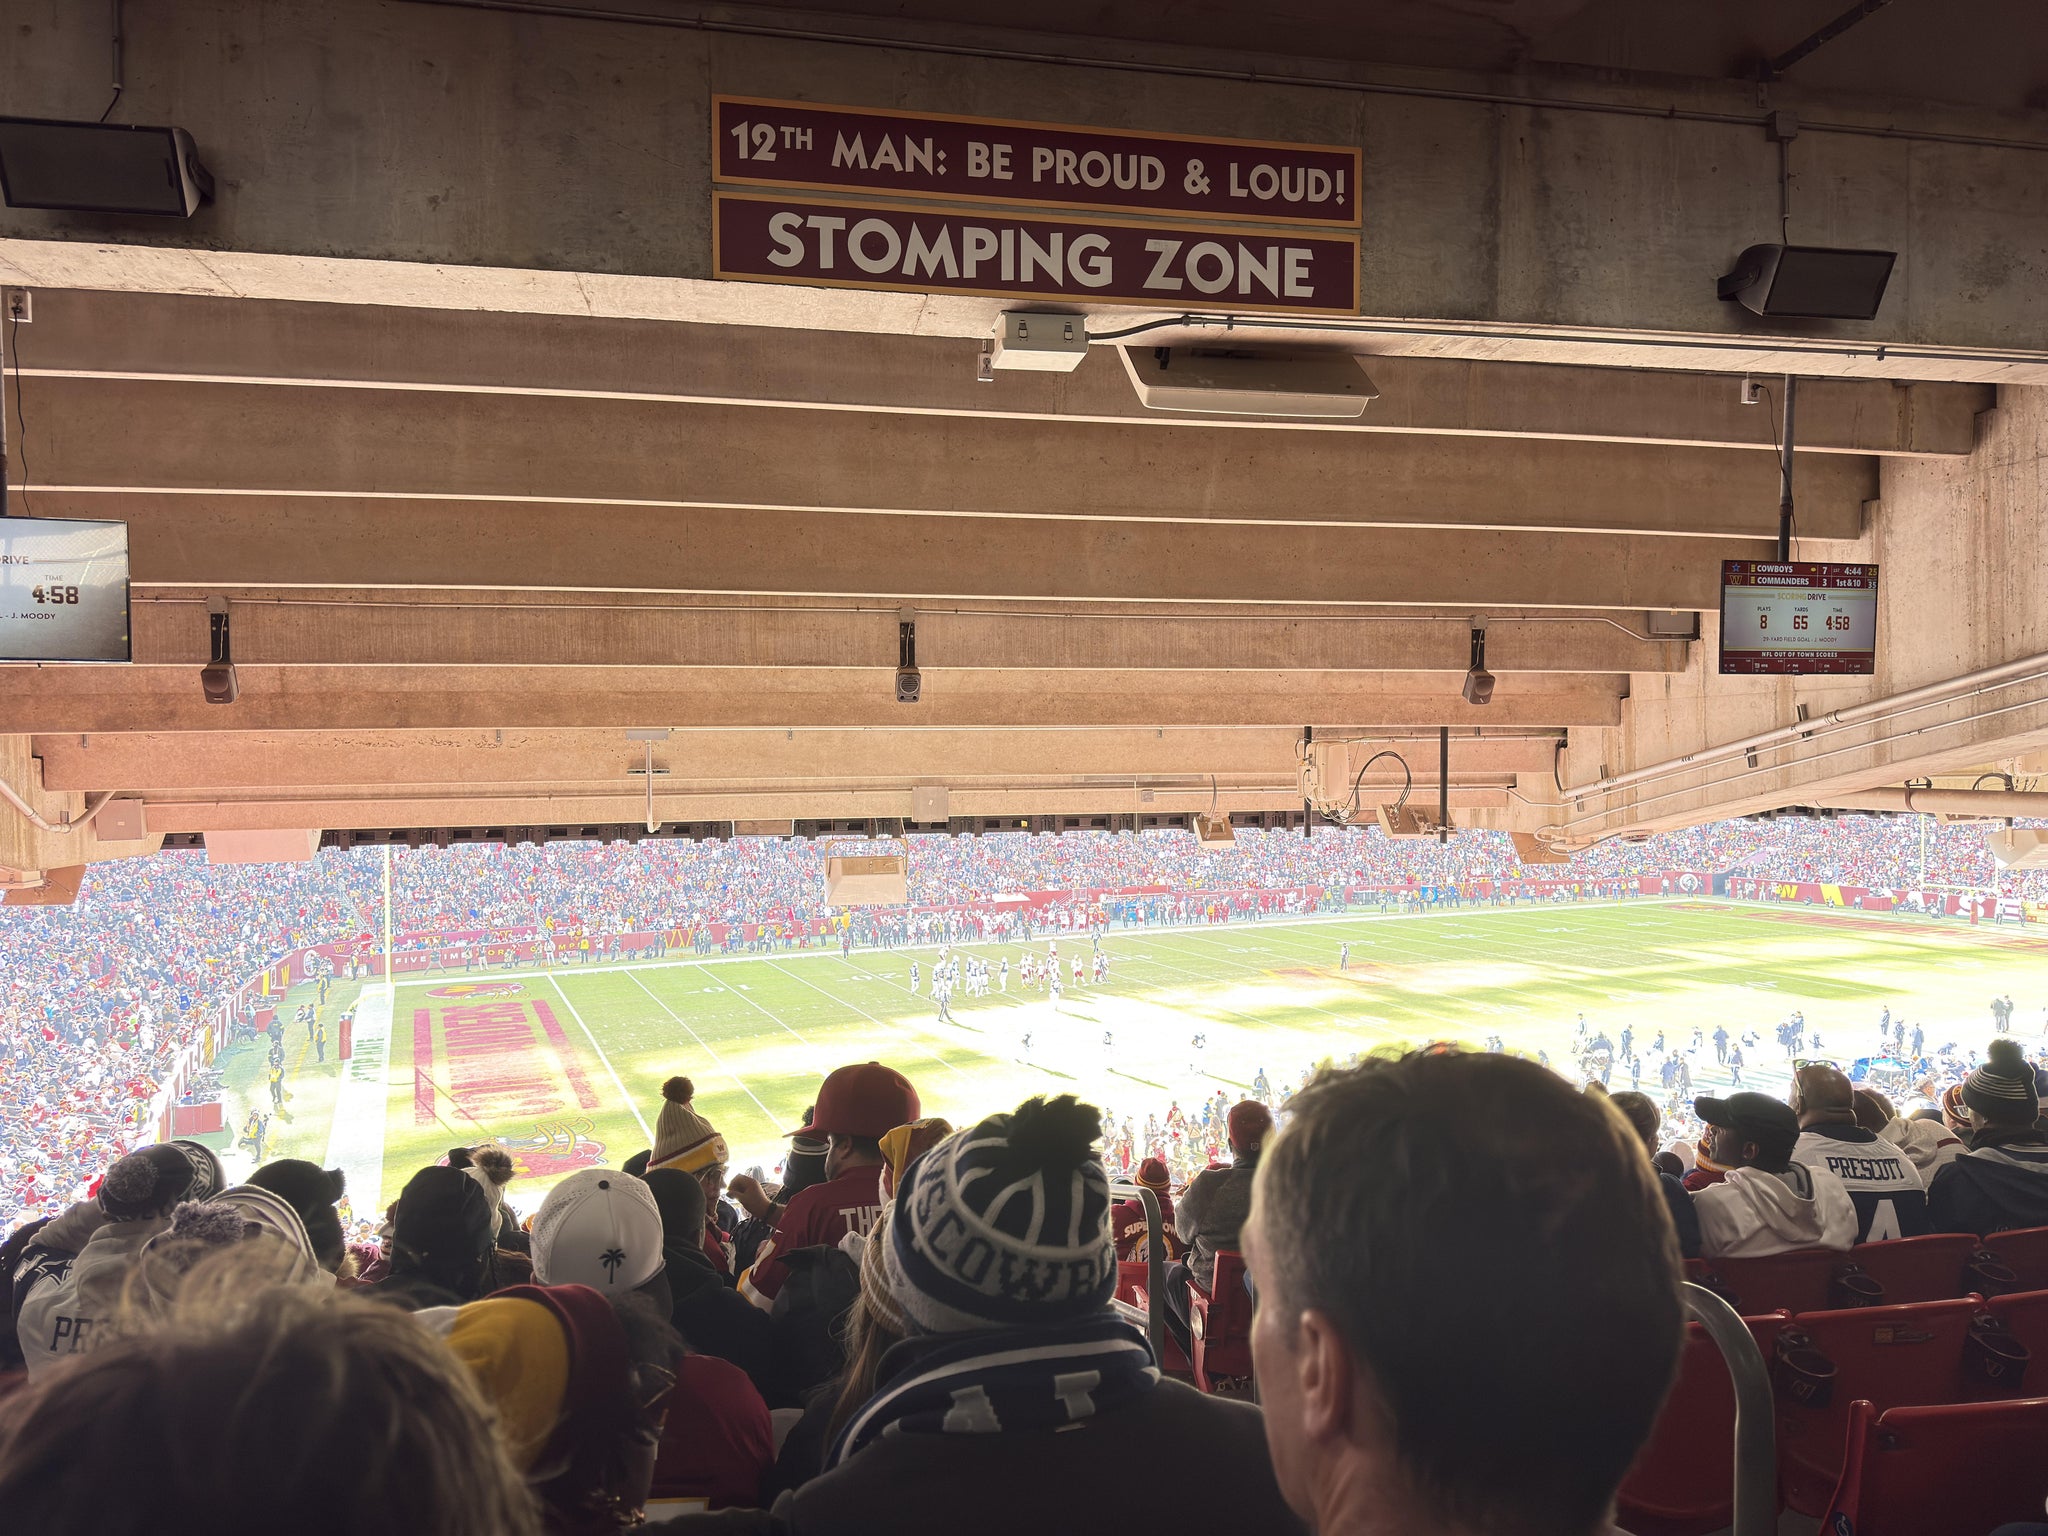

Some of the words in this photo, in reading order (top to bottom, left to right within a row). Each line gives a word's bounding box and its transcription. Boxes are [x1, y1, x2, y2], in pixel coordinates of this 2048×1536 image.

[730, 120, 813, 162] 12TH
[831, 129, 948, 176] MAN:
[967, 141, 1014, 181] BE
[1032, 147, 1166, 192] PROUD
[1183, 158, 1211, 196] &
[1229, 162, 1346, 206] LOUD!
[766, 211, 1113, 289] STOMPING
[1142, 238, 1315, 300] ZONE
[0, 555, 30, 565] RIVE
[1756, 564, 1793, 573] COWBOYS
[1822, 566, 1828, 575] 7
[1844, 566, 1862, 576] 4:44
[1868, 567, 1878, 576] 25
[1757, 576, 1809, 586] COMMANDERS
[1822, 578, 1828, 587] 3
[32, 584, 79, 605] 4:58
[1807, 593, 1826, 601] DRIVE
[1760, 615, 1767, 629] 8
[1793, 615, 1808, 630] 65
[1825, 616, 1850, 630] 4:58
[395, 954, 427, 965] FIVE
[1826, 1157, 1904, 1180] PRESCOTT
[1124, 1221, 1148, 1238] SUPE
